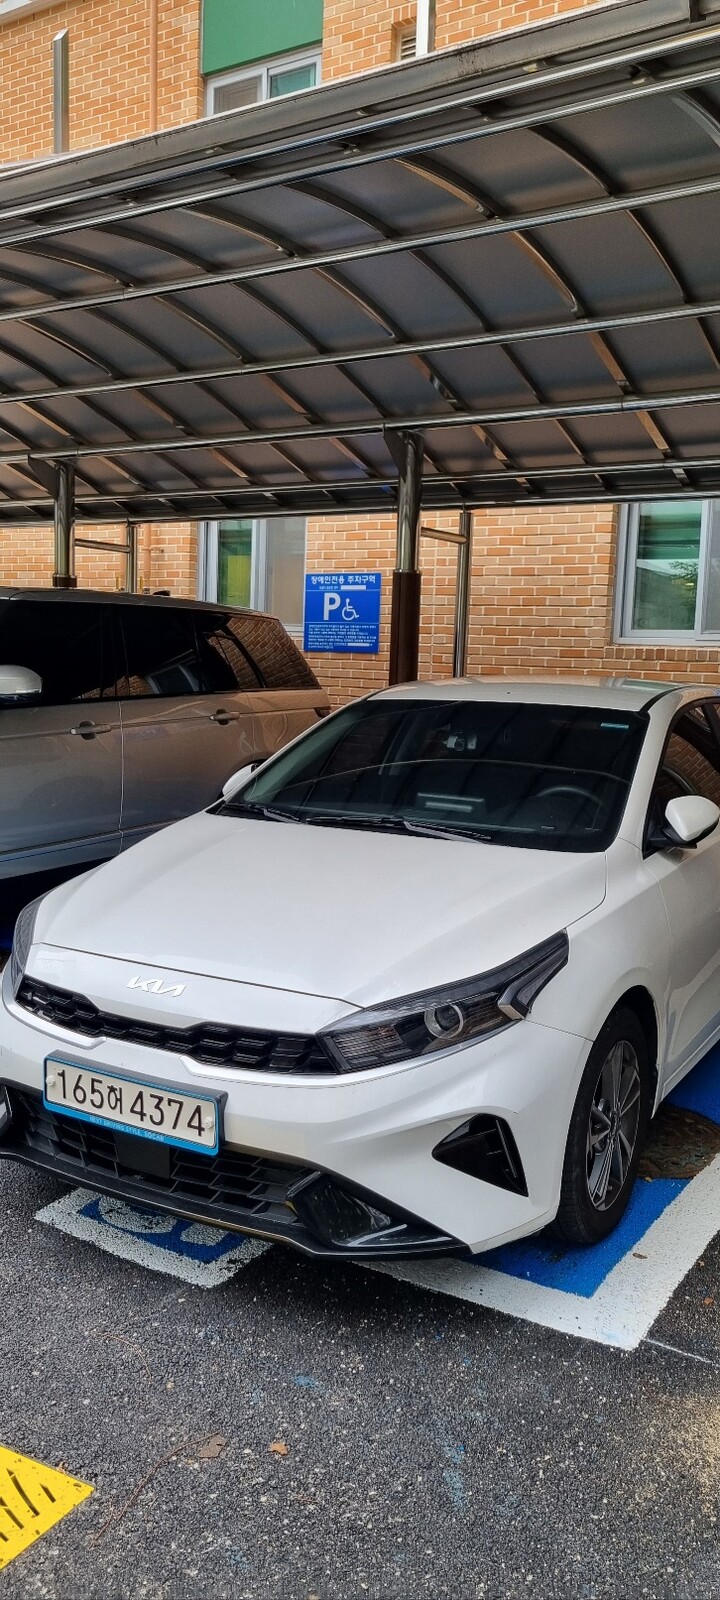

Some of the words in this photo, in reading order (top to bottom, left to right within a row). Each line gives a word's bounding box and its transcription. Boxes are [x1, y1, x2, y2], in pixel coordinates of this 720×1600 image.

[311, 575, 345, 585] 장애인전용
[347, 575, 376, 584] 주차구역
[323, 592, 341, 621] P
[57, 1069, 123, 1115] 165허
[129, 1090, 206, 1137] 4374
